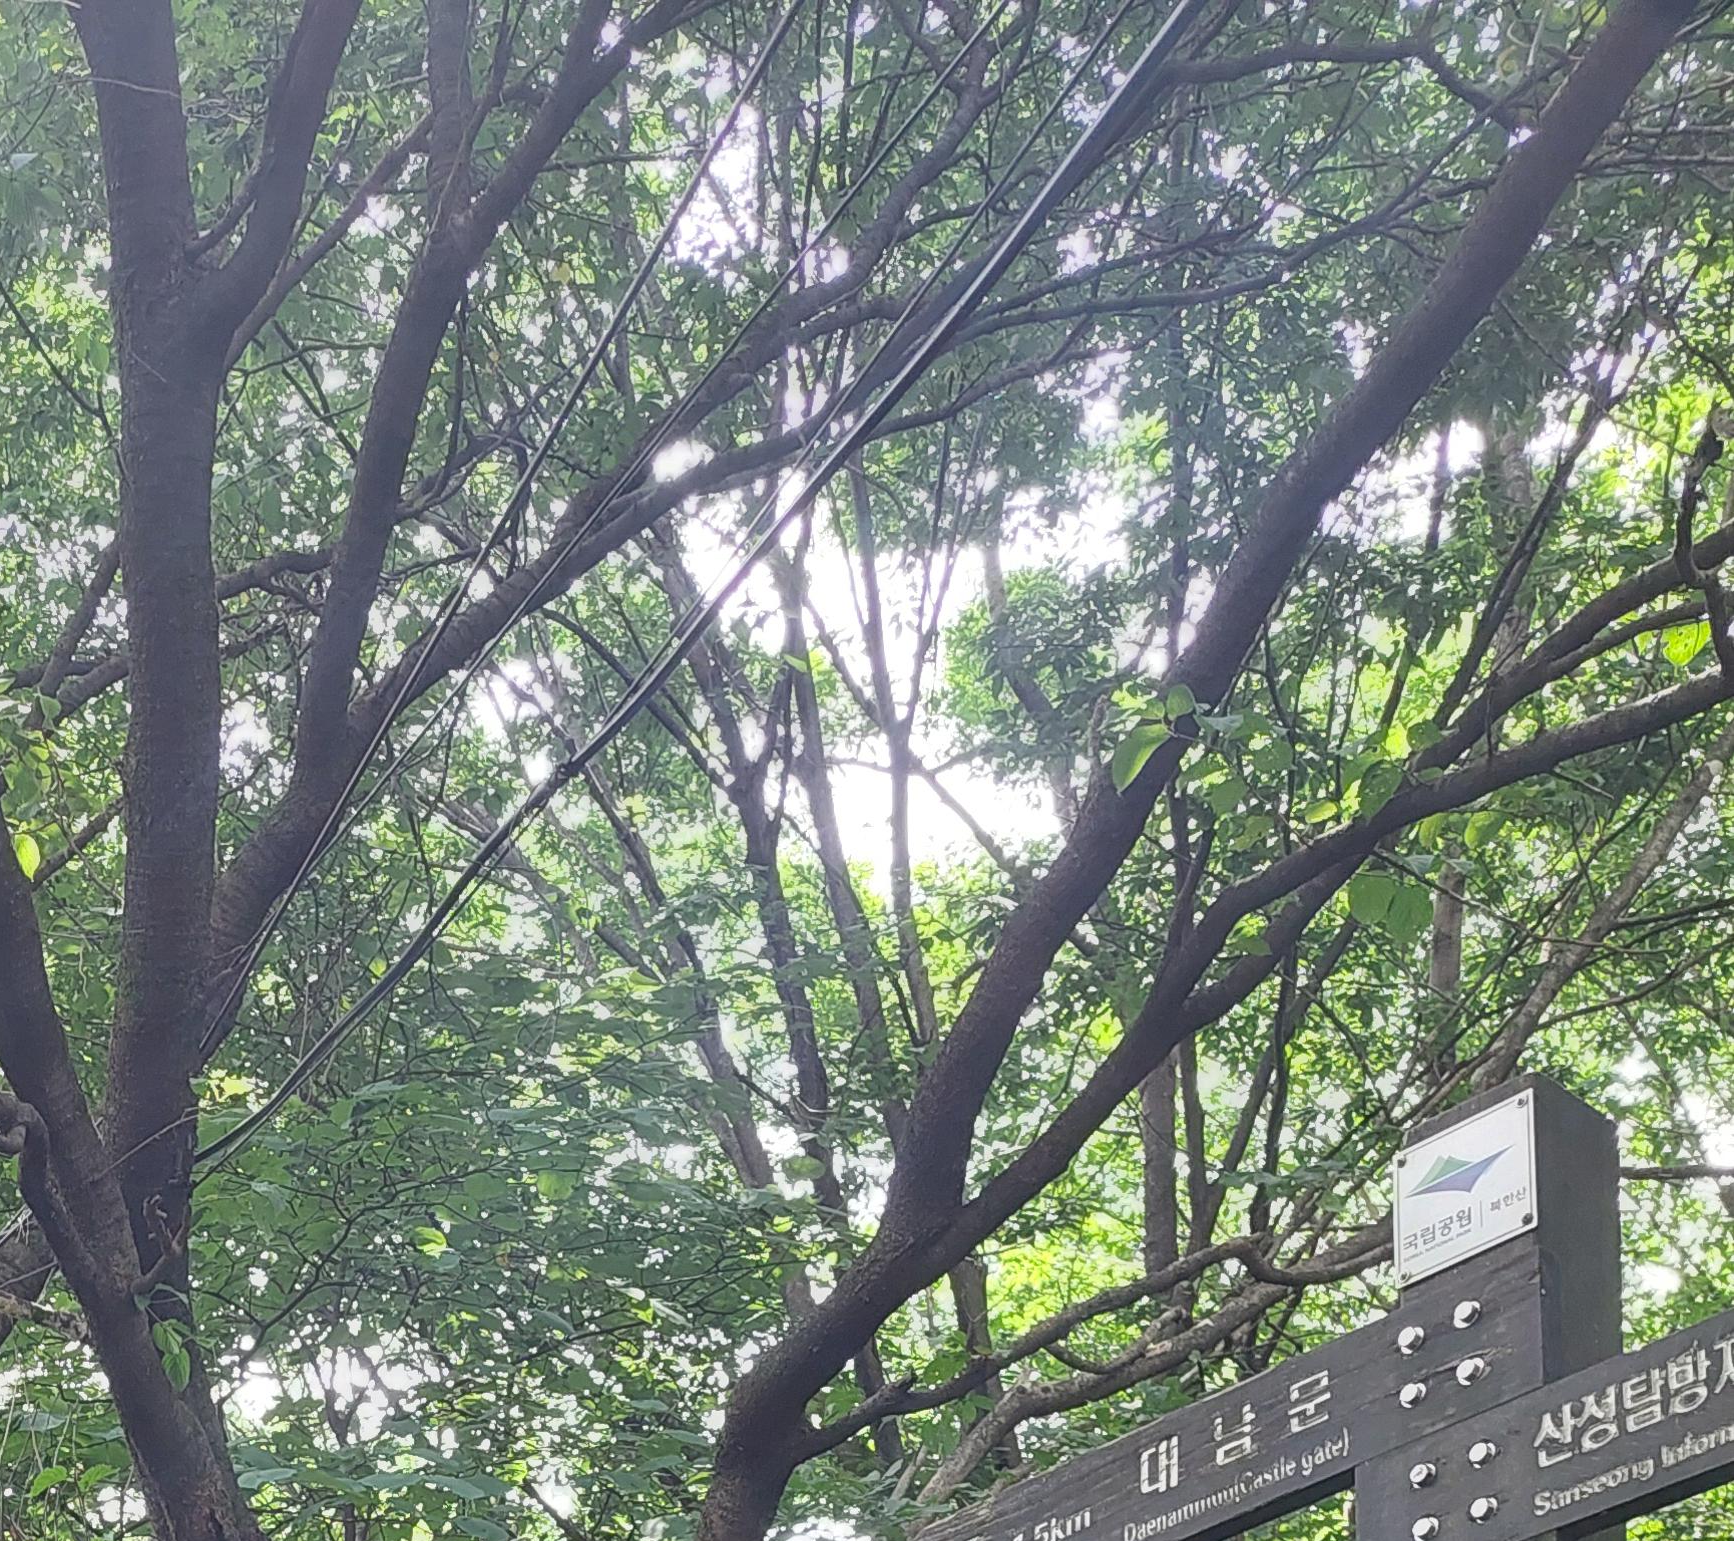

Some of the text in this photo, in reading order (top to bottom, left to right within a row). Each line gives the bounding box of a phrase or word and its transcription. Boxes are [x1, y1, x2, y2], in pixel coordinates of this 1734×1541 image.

[1403, 1186, 1527, 1250] 국립공원 북한산
[1301, 1426, 1351, 1477] gate)
